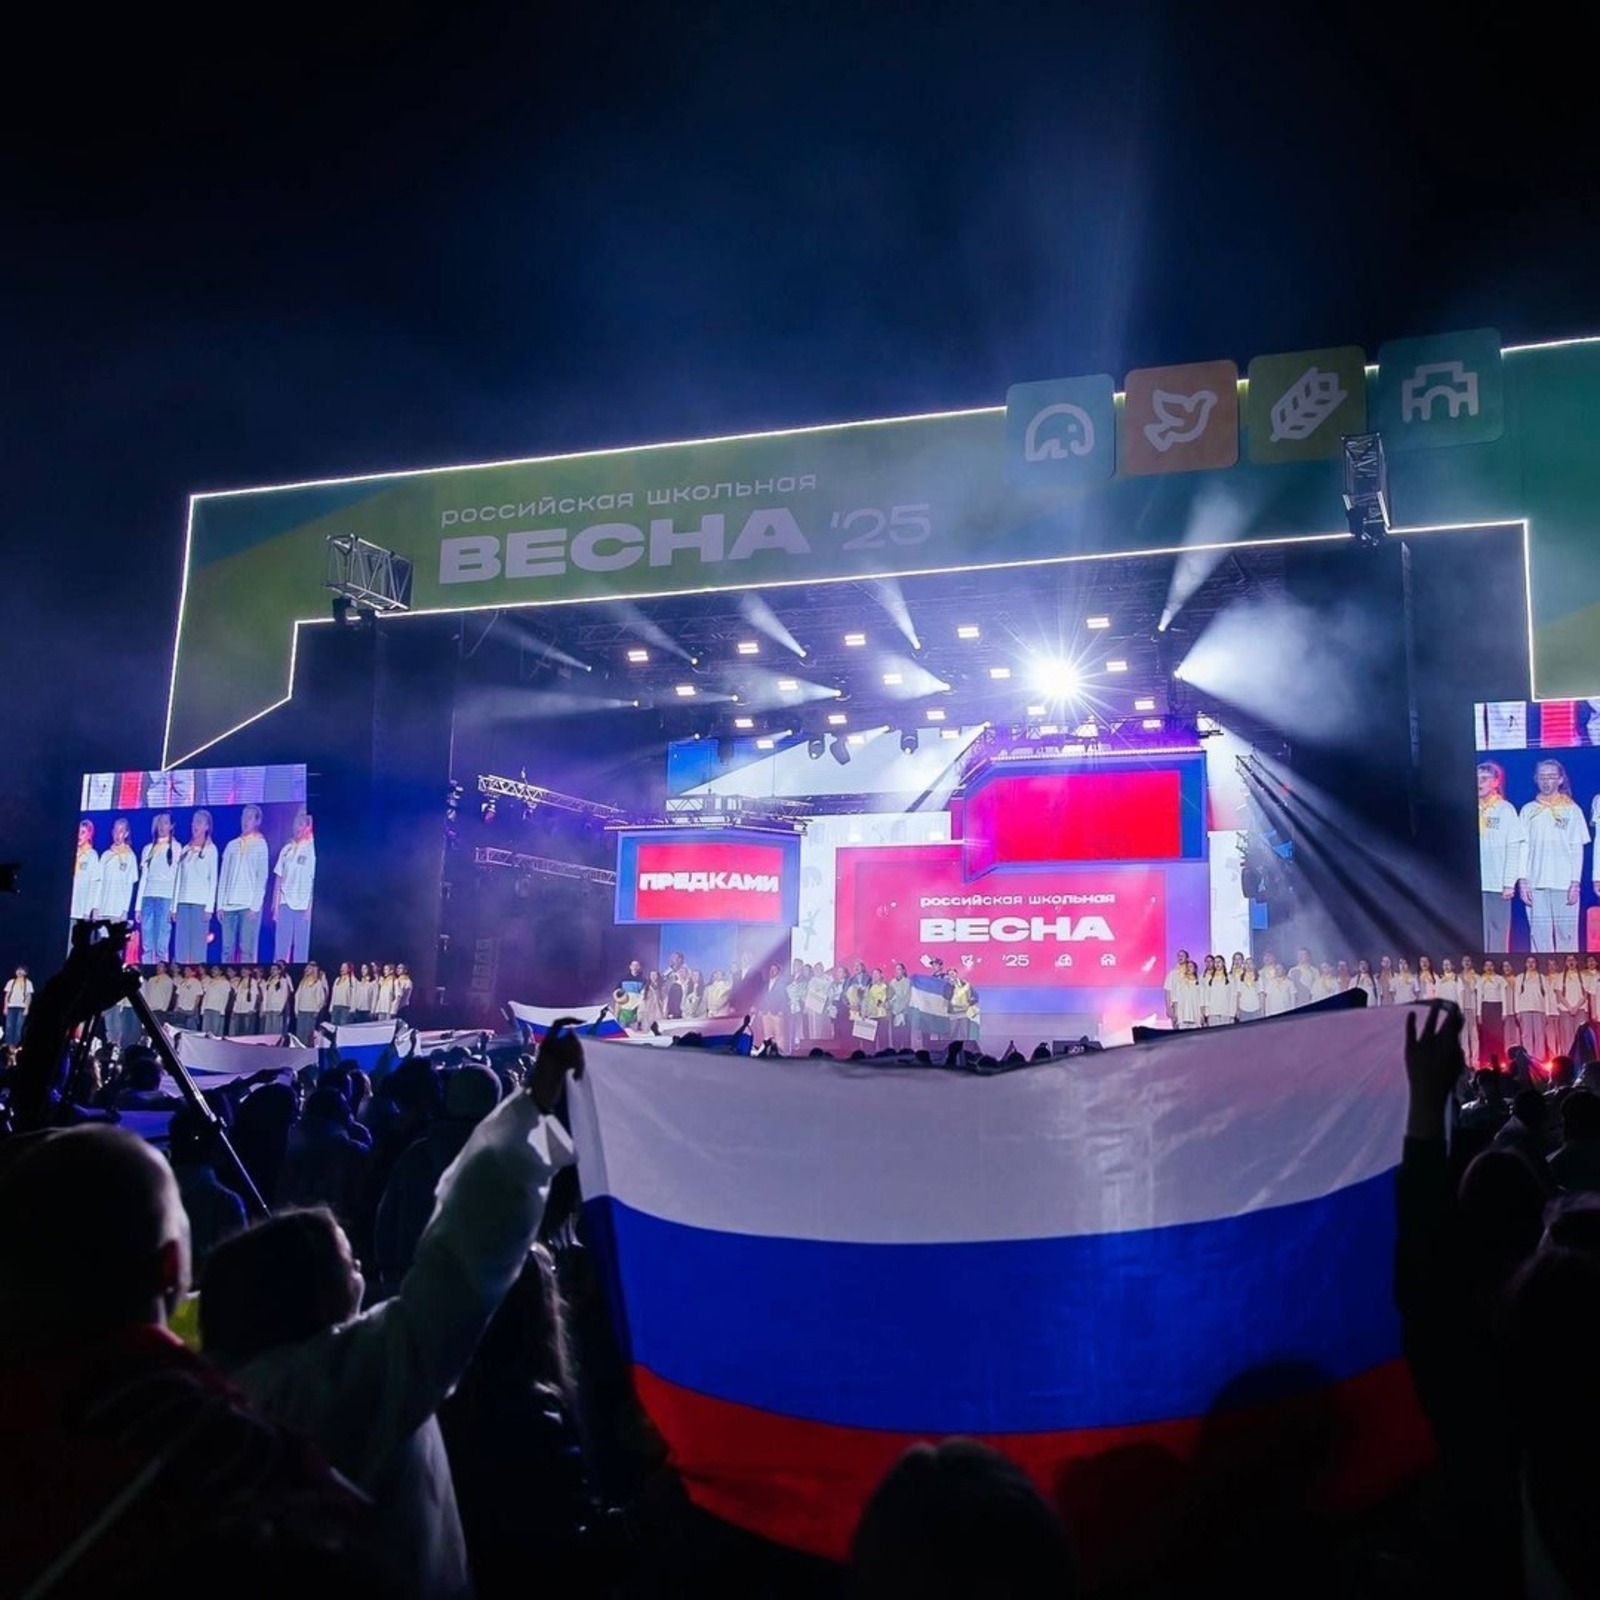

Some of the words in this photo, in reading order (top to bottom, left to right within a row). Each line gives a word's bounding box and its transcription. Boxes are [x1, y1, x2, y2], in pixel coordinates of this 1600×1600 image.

[440, 491, 634, 528] российская
[647, 474, 817, 506] школьная
[439, 507, 811, 584] ВЕСНА
[639, 872, 780, 893] ПРЕДКАМИ
[920, 894, 1022, 908] российская
[1029, 893, 1116, 905] школьная
[919, 916, 1116, 943] ВЕСНА
